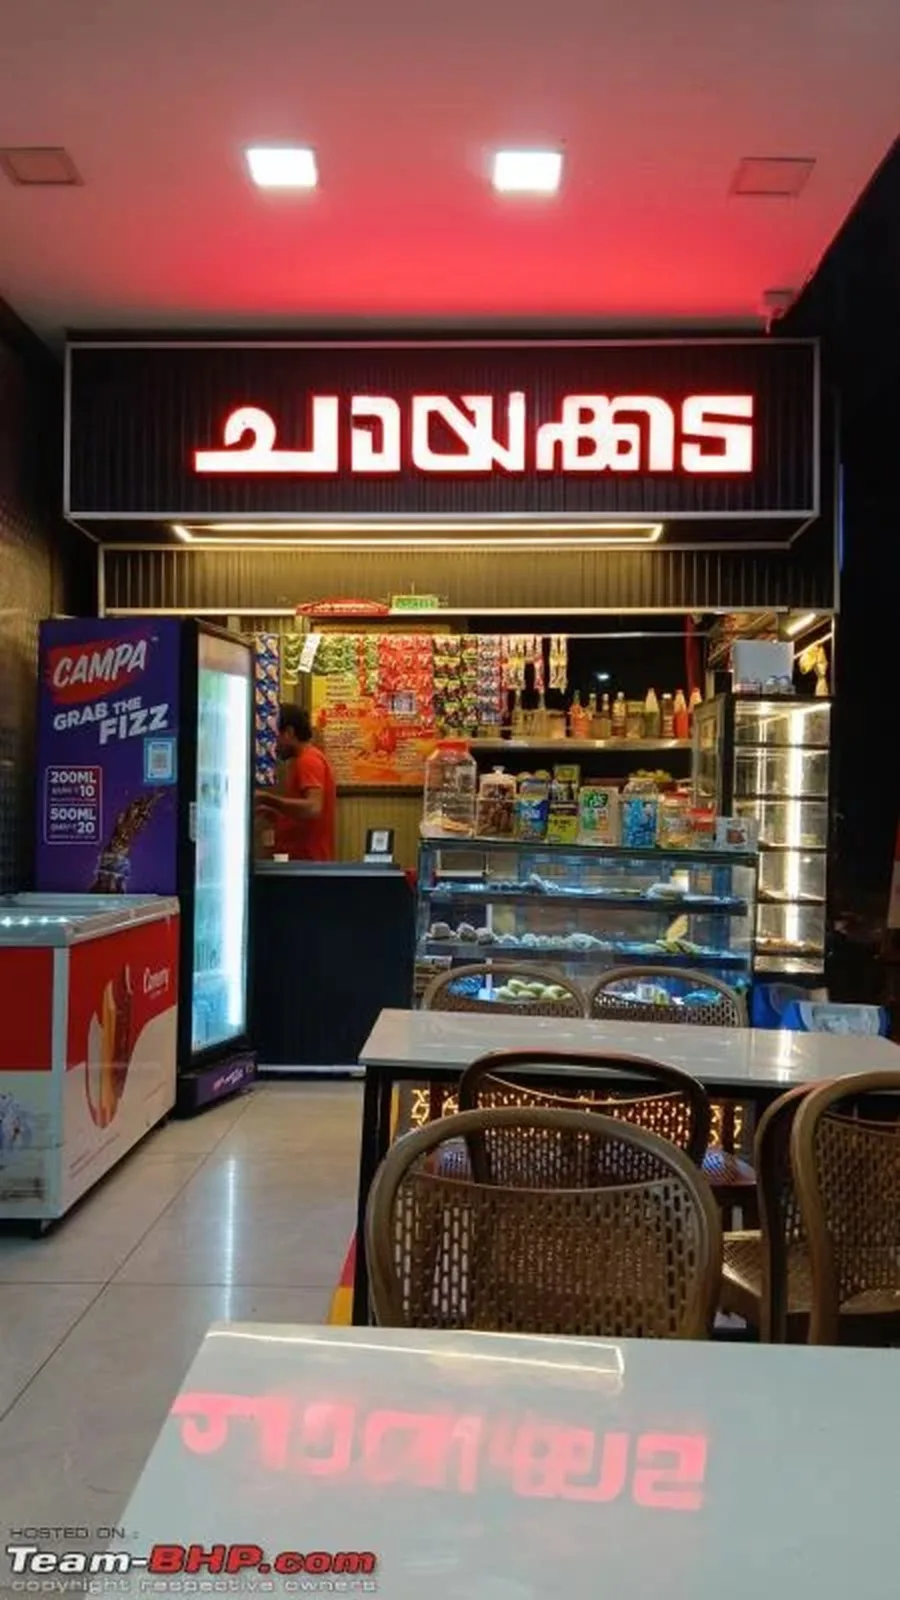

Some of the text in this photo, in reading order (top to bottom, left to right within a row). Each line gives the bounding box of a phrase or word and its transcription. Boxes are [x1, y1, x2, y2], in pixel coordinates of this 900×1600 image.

[195, 391, 754, 473] ചായക്കട
[52, 639, 148, 688] CAMPA
[53, 696, 143, 731] GRAB THE
[99, 703, 169, 744] FIZZ
[50, 771, 97, 783] 200ML
[50, 808, 97, 820] 500ML
